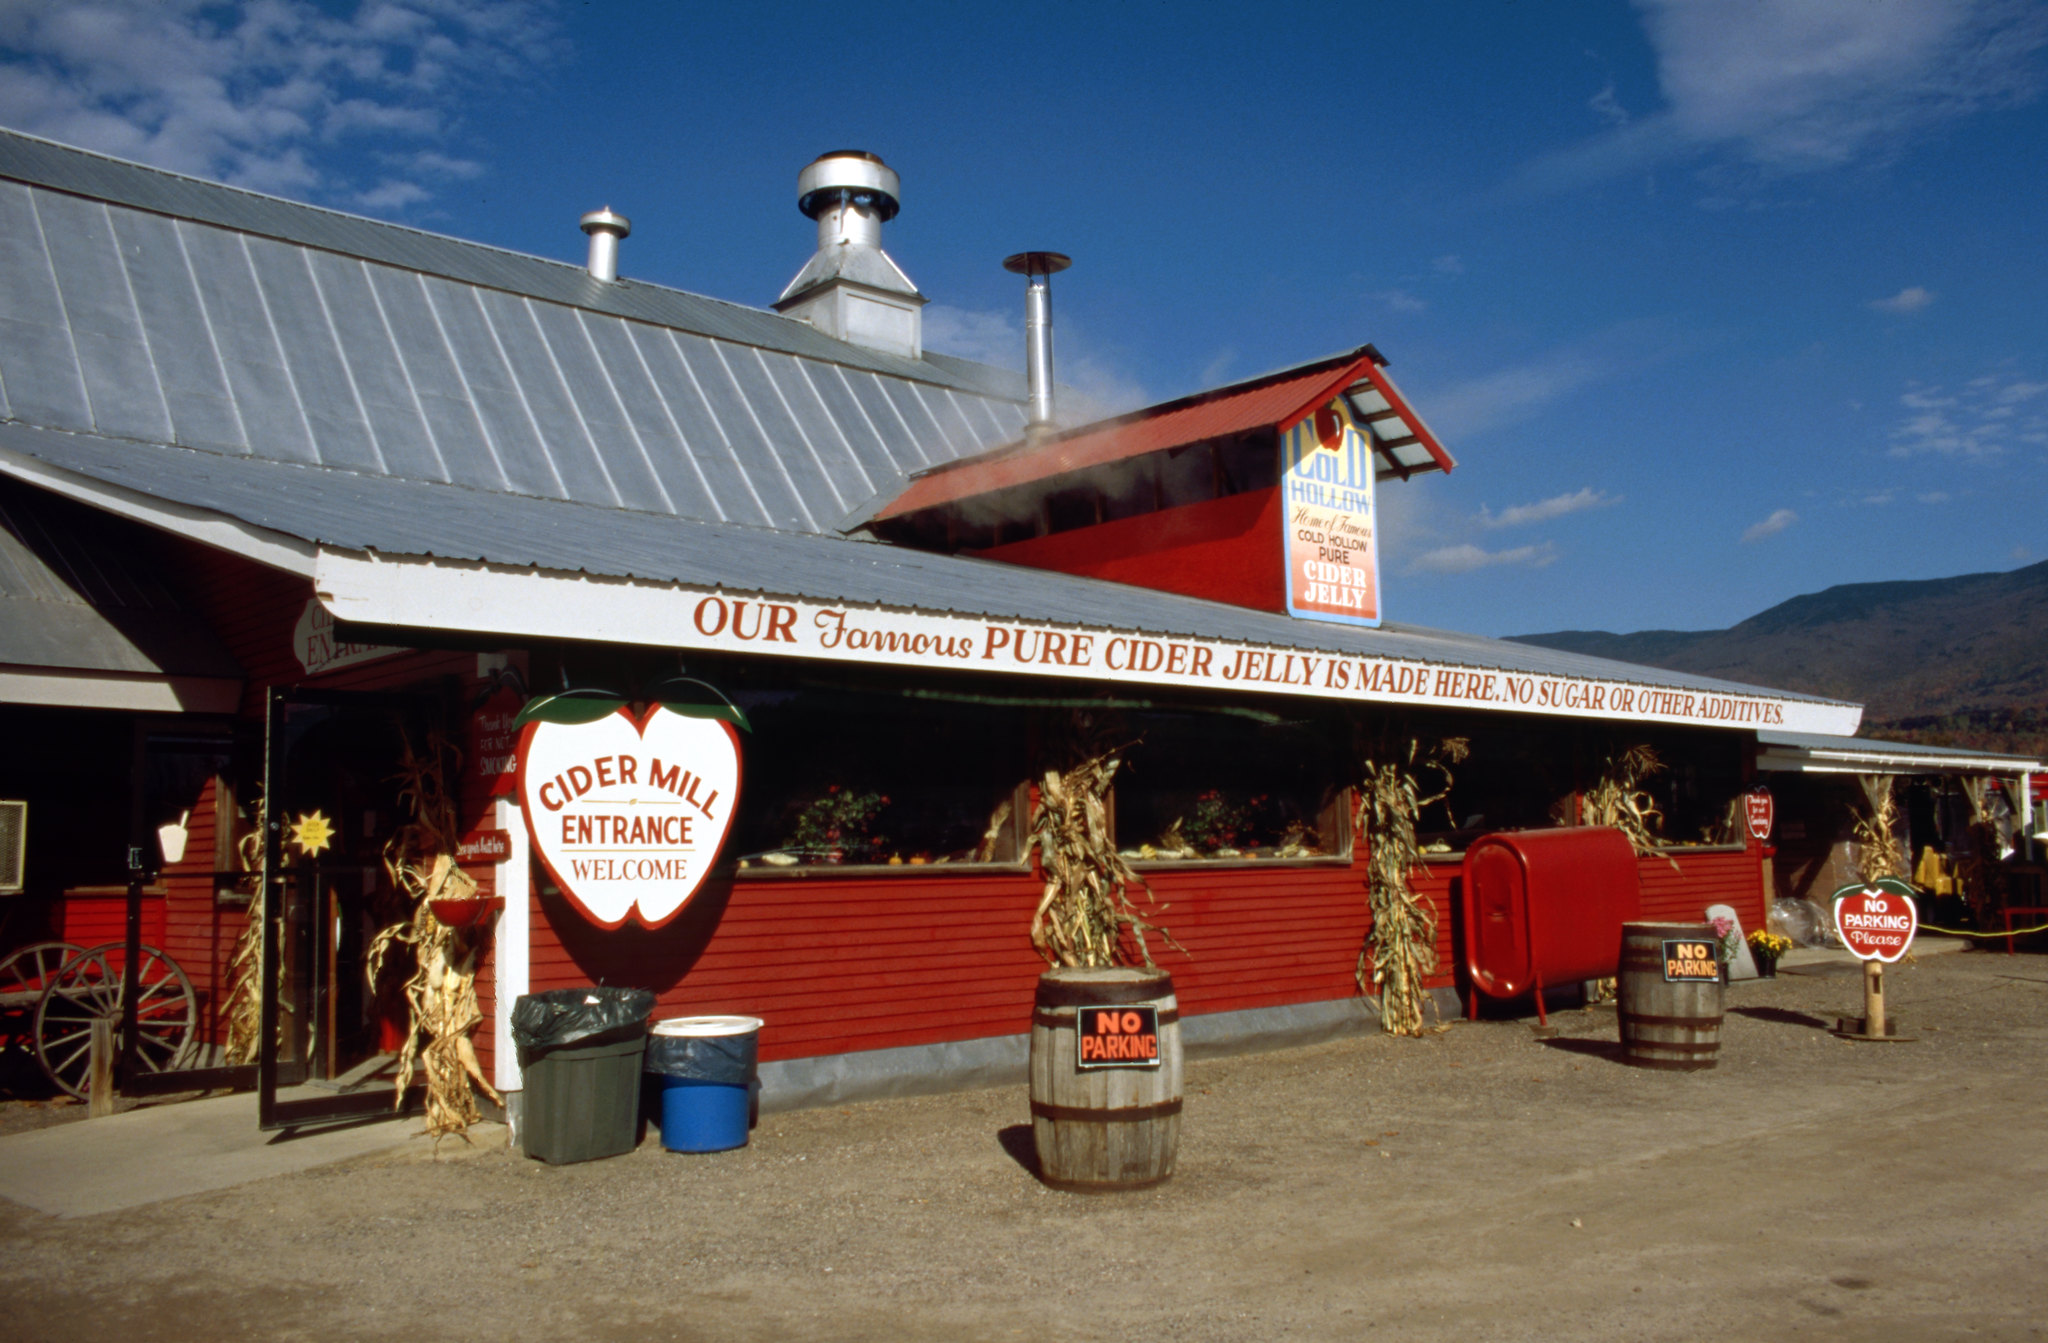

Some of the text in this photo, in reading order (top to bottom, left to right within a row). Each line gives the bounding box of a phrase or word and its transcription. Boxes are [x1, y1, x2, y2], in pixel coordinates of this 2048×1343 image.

[1291, 479, 1371, 515] HOLLOW
[1291, 506, 1372, 538] Home of Famous
[1298, 529, 1367, 552] COLD HOLLOW
[1319, 547, 1350, 565] PURE
[1303, 559, 1367, 588] CIDER
[1304, 582, 1366, 609] JELLY
[694, 597, 1784, 725] OUR Famous PURE CIDER JELLY IS MADE HERE. NO SUGAR OR OTHER ADDITIVES.
[480, 754, 517, 776] SMOKING
[539, 754, 719, 821] CIDER MILL
[562, 815, 693, 845] ENTRANCE
[571, 859, 688, 881] WELCOME
[1864, 899, 1888, 913] NO
[1845, 914, 1910, 929] PARKING
[1851, 931, 1902, 946] Please
[1677, 943, 1707, 959] NO
[1667, 959, 1717, 976] PARKING
[1097, 1012, 1142, 1034] NO
[1082, 1034, 1157, 1059] PARKING
